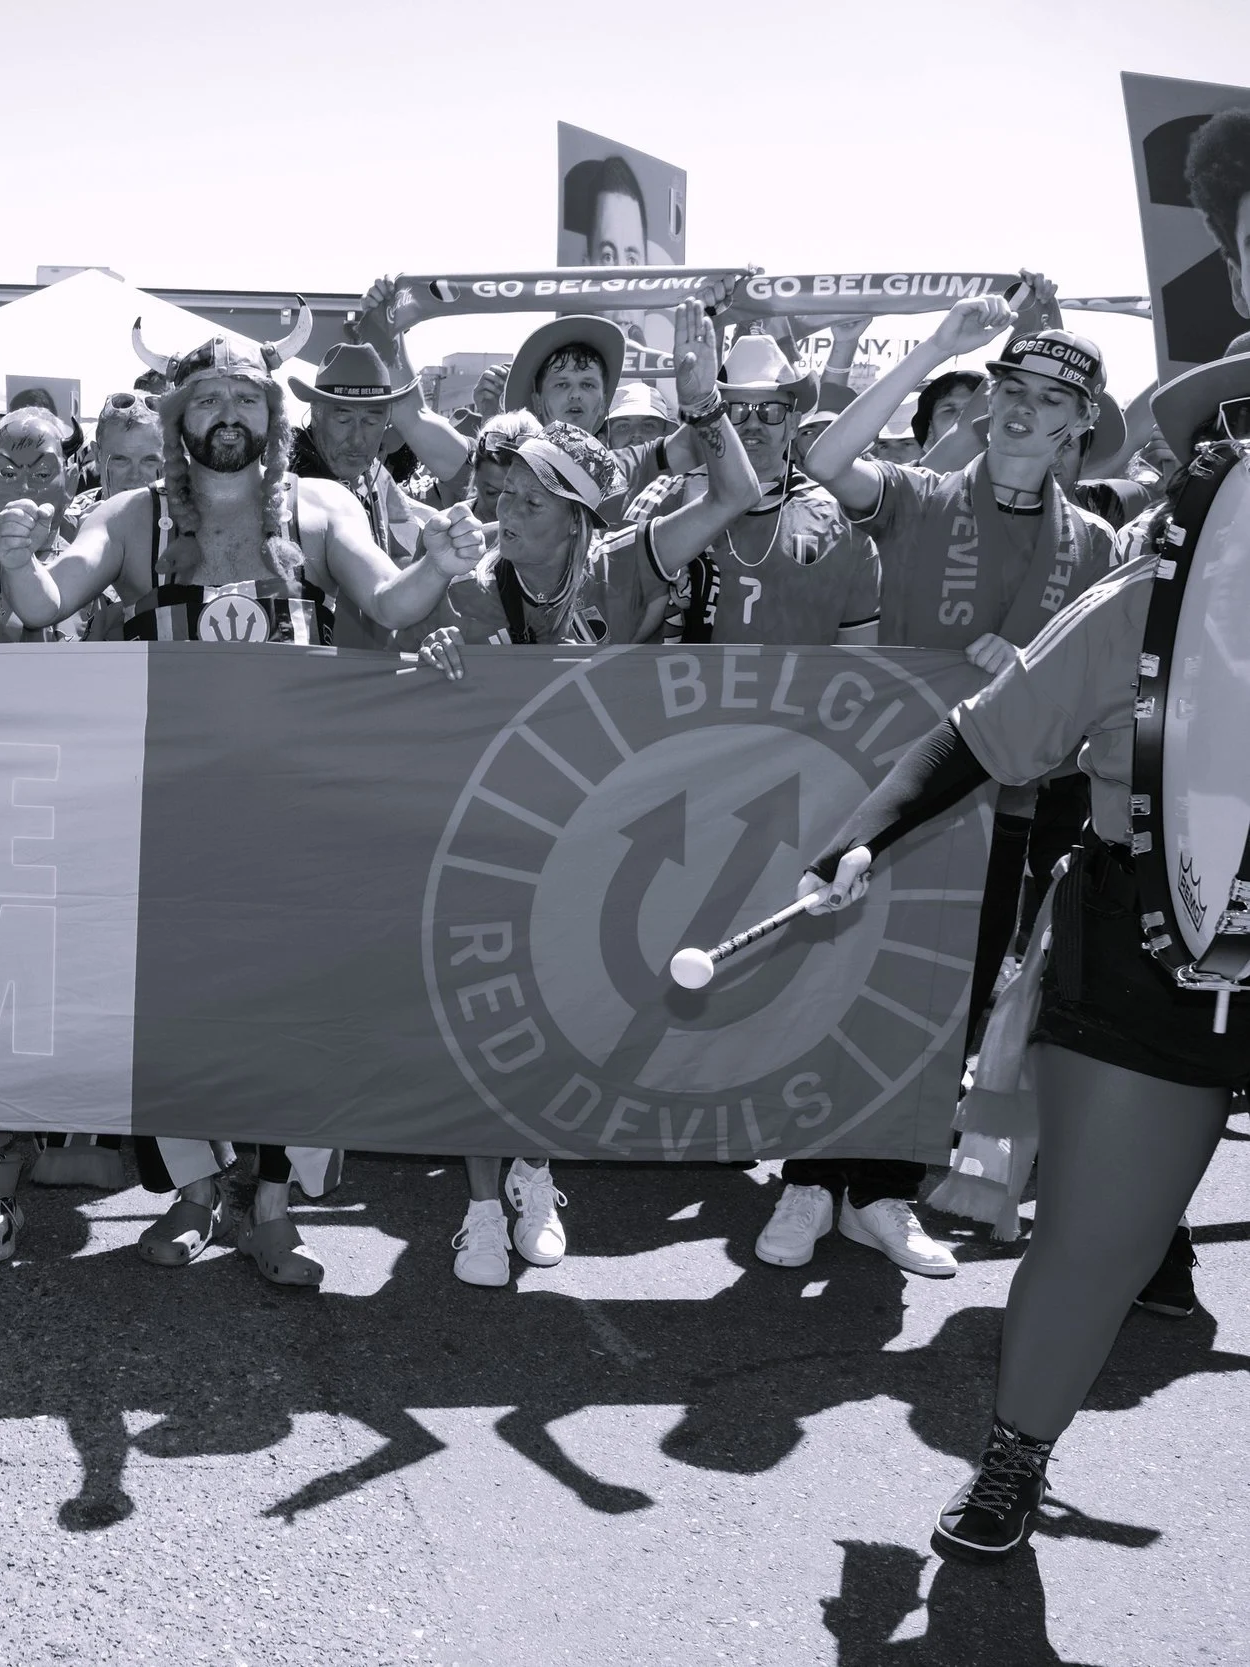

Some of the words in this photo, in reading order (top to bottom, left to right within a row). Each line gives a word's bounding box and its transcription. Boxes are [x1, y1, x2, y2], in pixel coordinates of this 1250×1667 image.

[472, 280, 523, 297] GO
[534, 276, 707, 295] BELGIUM!
[746, 277, 801, 300] GO
[1025, 341, 1092, 372] BELGIUM
[739, 576, 762, 624] 7
[449, 921, 546, 1074] RED
[539, 1072, 833, 1163] DEVILS
